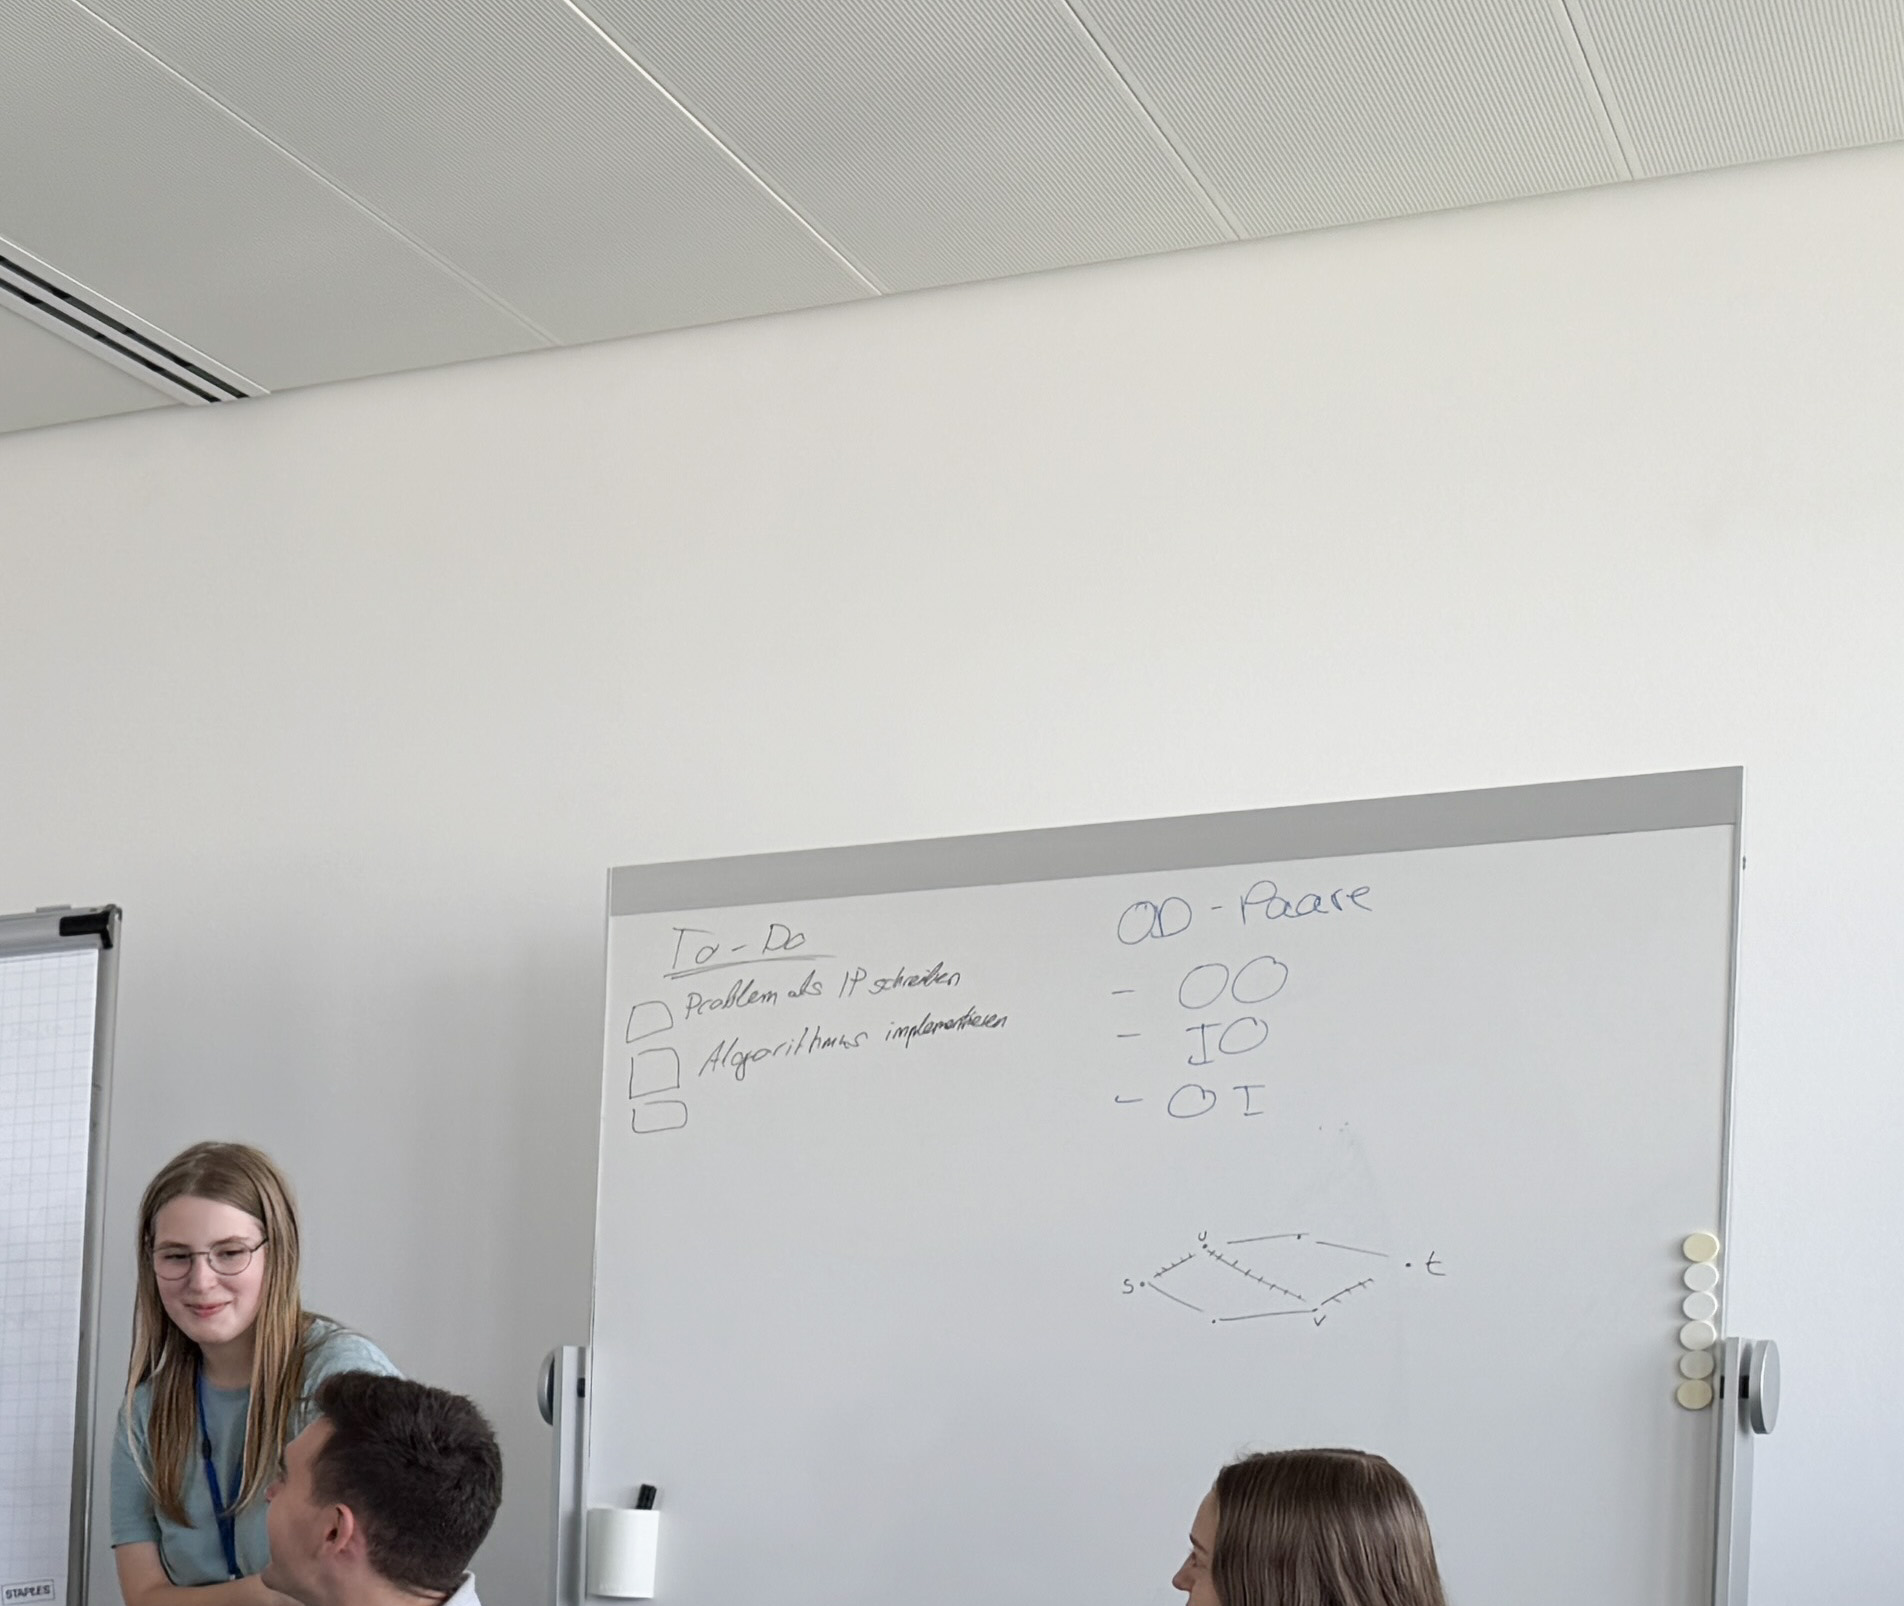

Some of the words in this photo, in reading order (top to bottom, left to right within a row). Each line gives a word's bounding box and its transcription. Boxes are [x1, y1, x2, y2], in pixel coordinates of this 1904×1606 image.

[685, 980, 779, 1022] Problem
[788, 971, 824, 999] als
[4, 1584, 52, 1600] STAPLES
